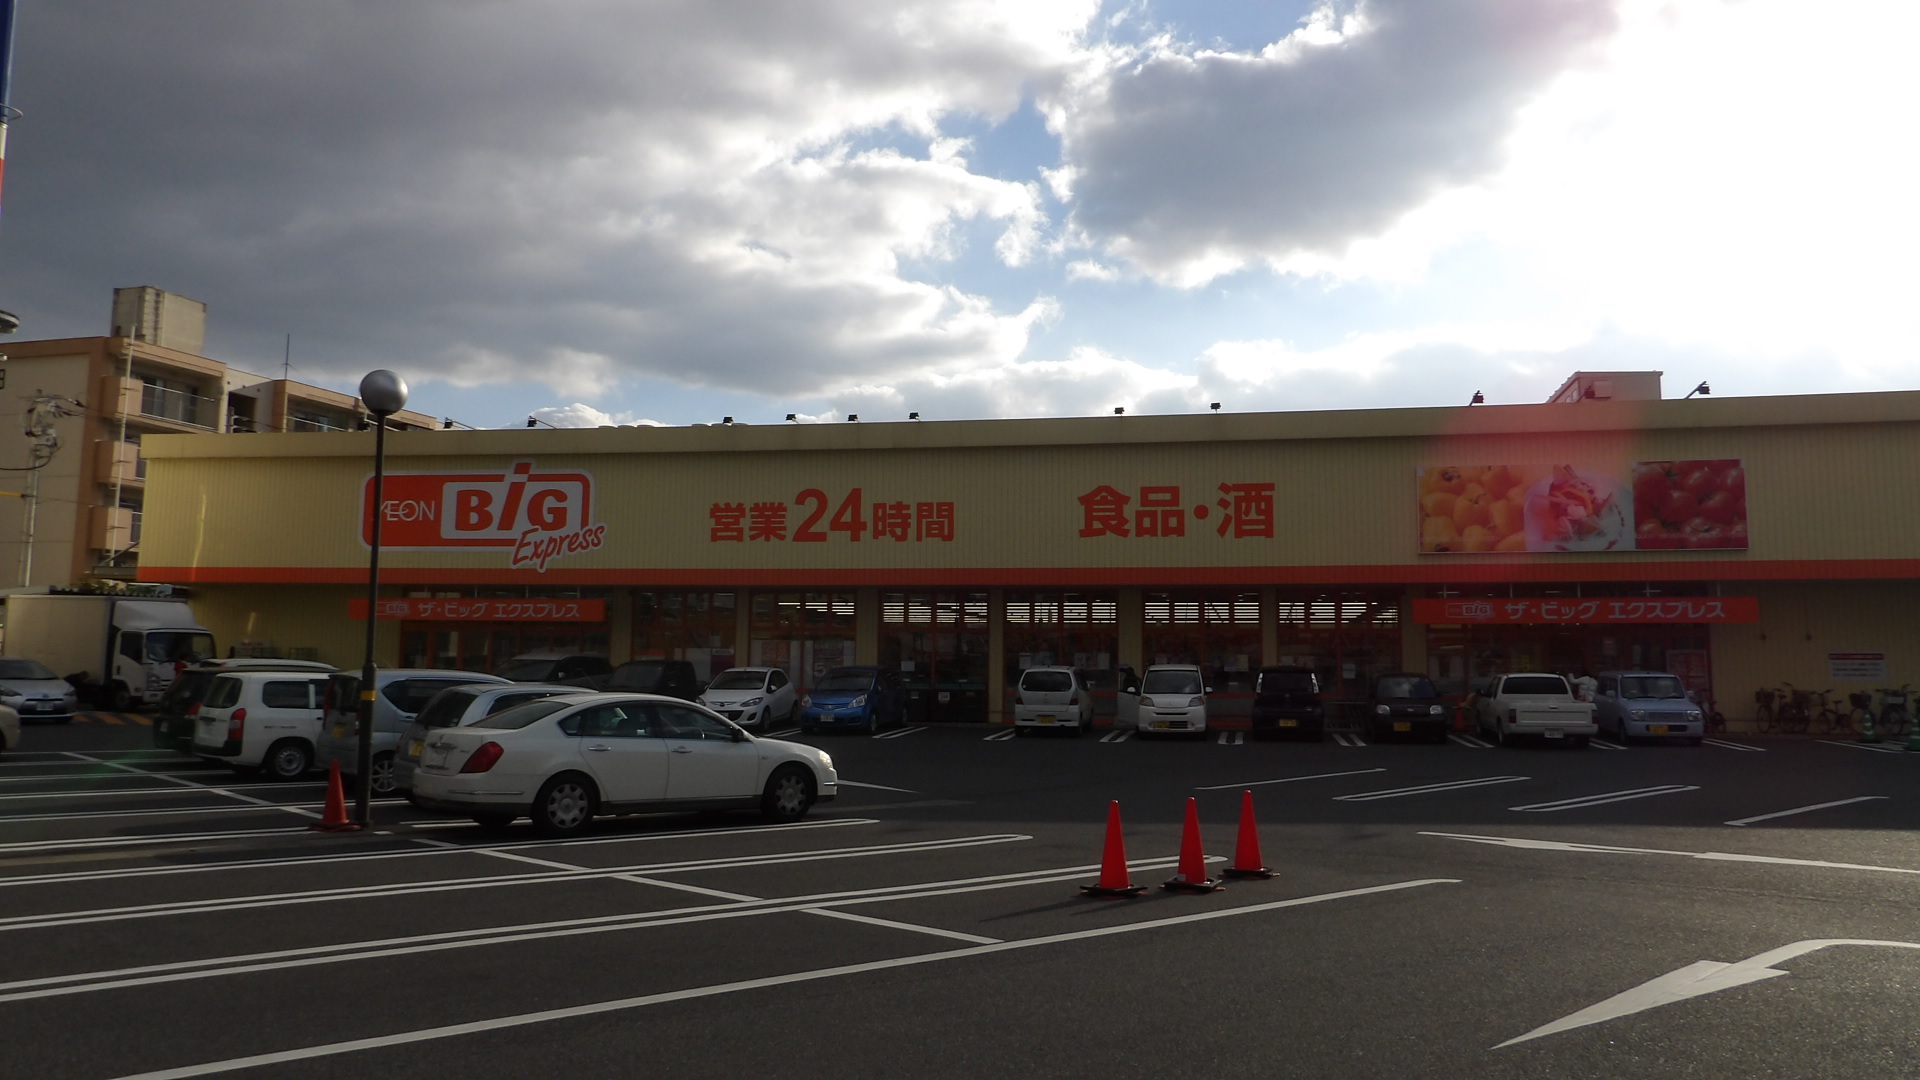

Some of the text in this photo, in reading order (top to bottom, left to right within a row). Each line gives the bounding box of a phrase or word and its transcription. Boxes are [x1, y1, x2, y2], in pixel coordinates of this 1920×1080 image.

[709, 488, 955, 543] 営業24時間
[512, 524, 606, 570] Express
[494, 602, 580, 618] エクスプレス
[1608, 601, 1726, 619] エクスプレス
